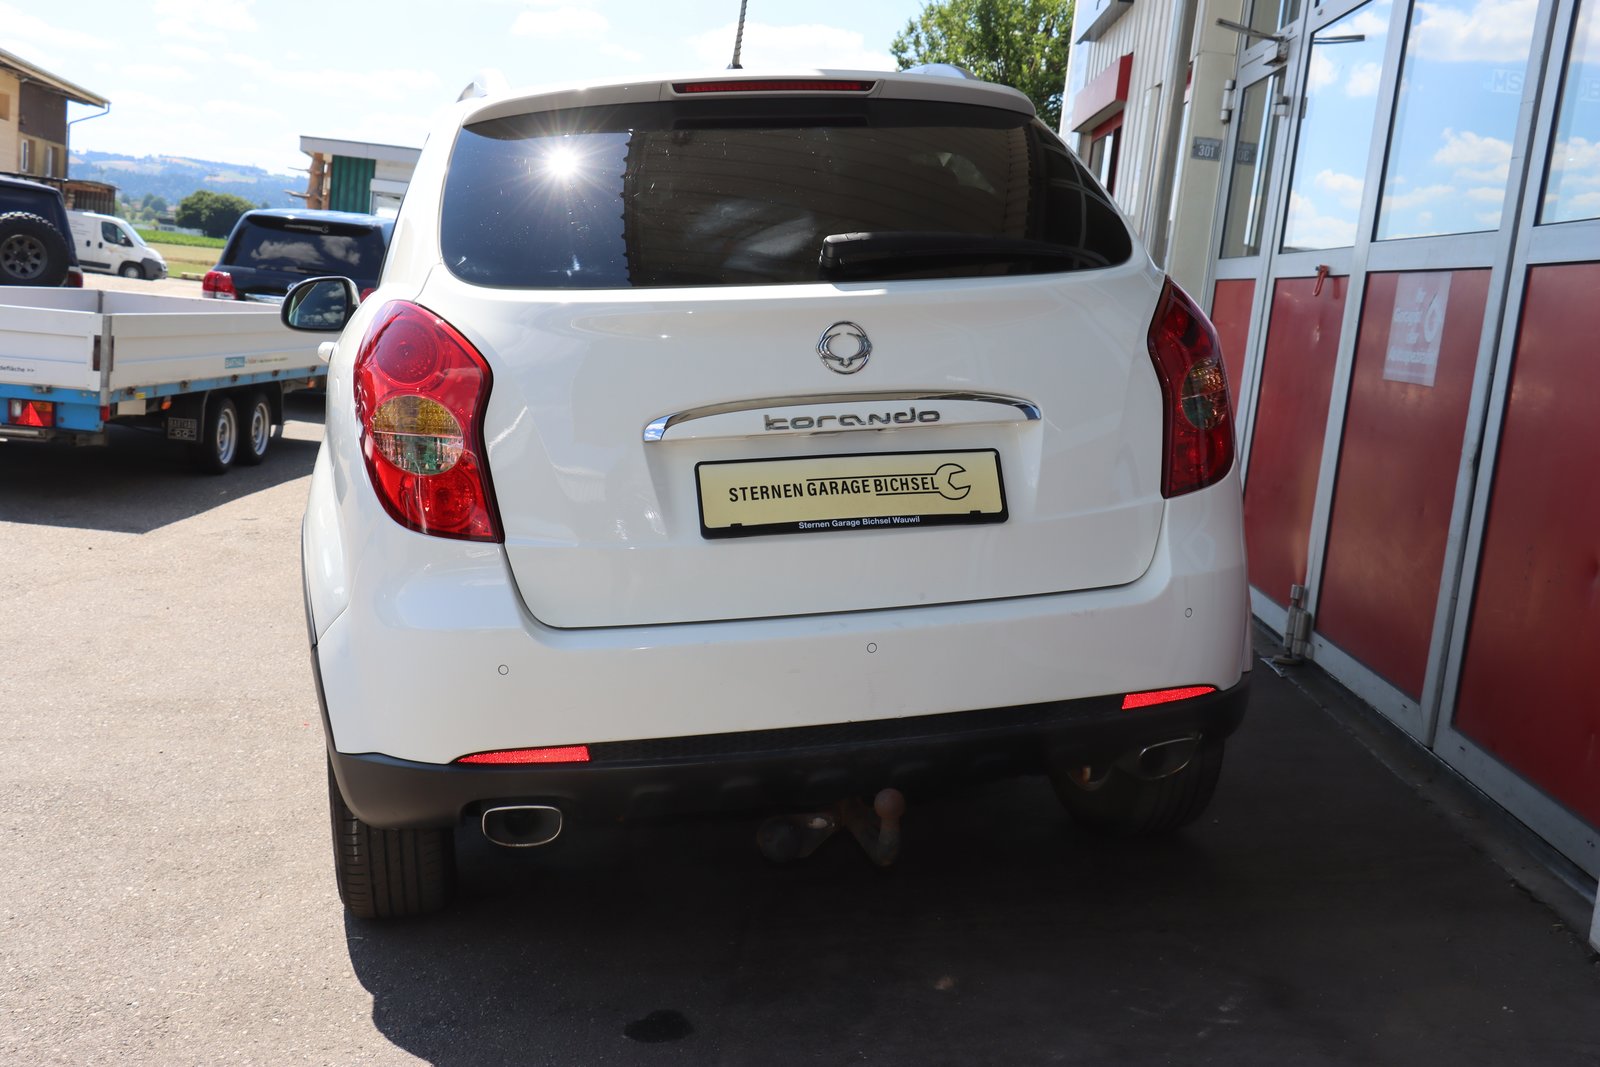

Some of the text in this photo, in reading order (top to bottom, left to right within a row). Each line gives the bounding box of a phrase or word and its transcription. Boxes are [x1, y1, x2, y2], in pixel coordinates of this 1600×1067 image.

[1198, 144, 1215, 158] 301
[764, 406, 941, 431] korando
[729, 476, 940, 502] STERNEN GARAGE BICHSEL
[798, 515, 921, 529] Sternen Garage Bichsel Wauwil
